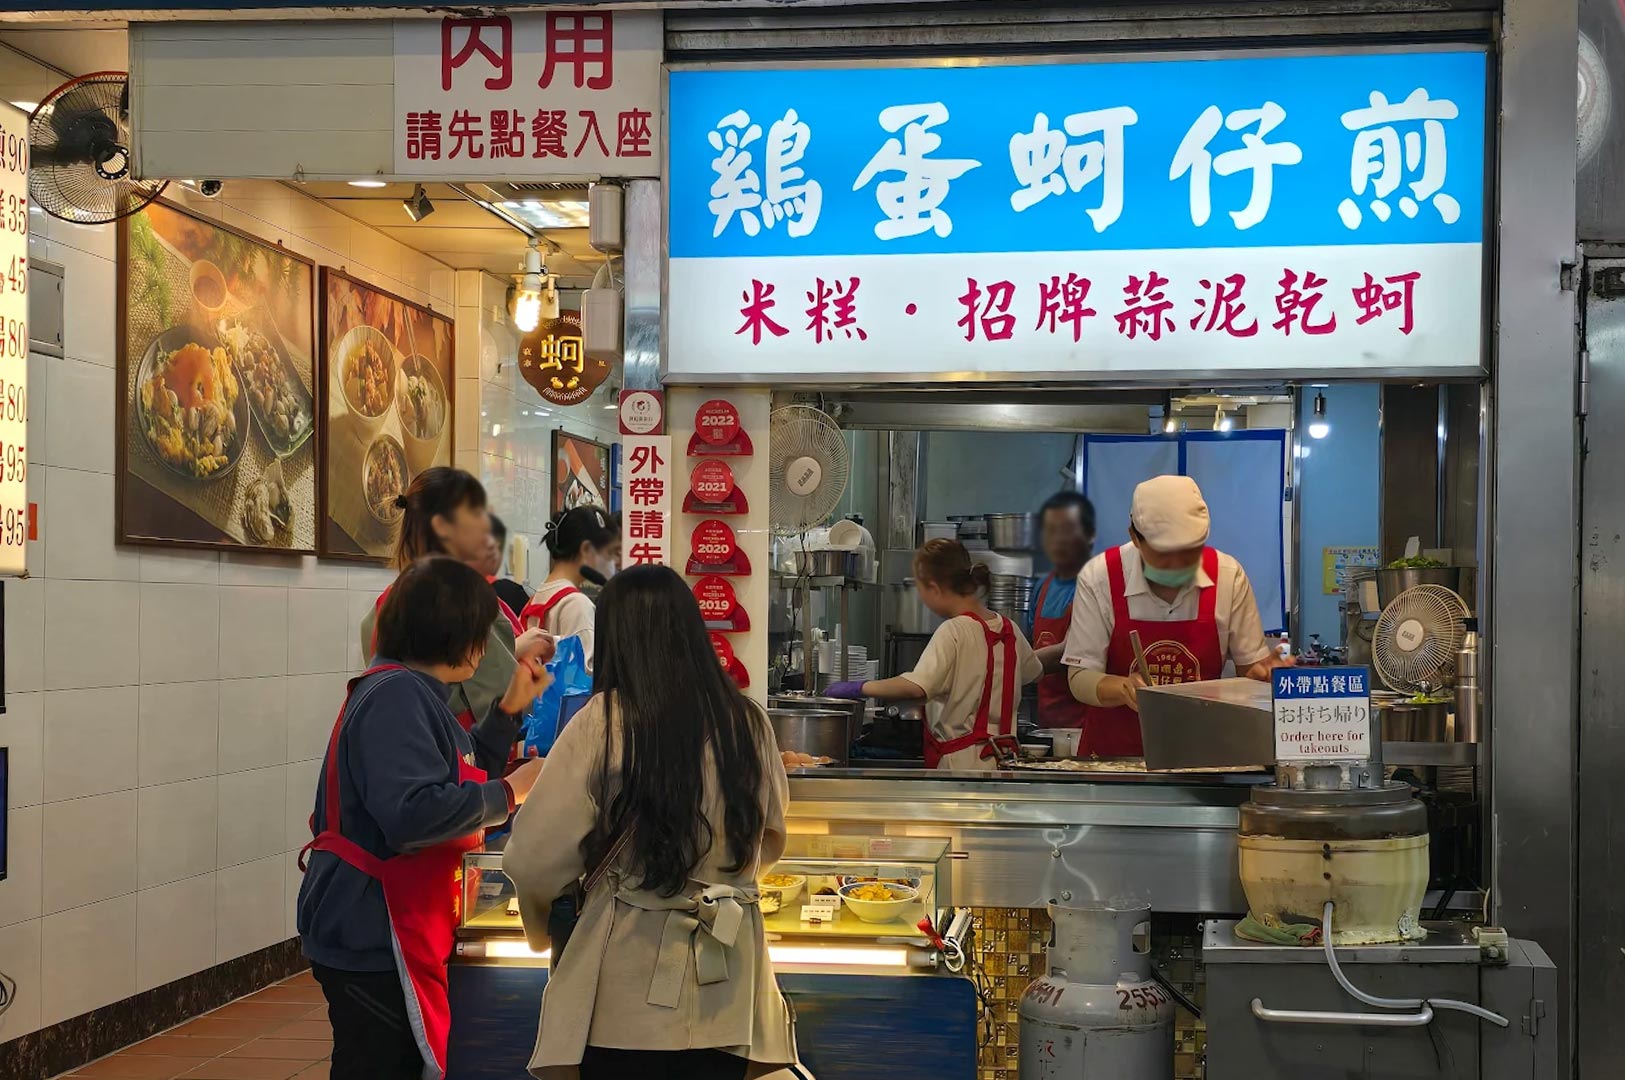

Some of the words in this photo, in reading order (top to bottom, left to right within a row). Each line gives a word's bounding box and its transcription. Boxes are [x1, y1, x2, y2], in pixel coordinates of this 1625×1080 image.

[407, 108, 652, 160] 請先點餐入座
[539, 334, 584, 373] 蚵
[702, 415, 735, 426] 2022
[698, 482, 727, 492] 2021
[629, 446, 664, 566] 外帶請先
[698, 544, 730, 554] 2020
[699, 600, 730, 610] 2019
[1279, 675, 1364, 694] 外帶點餐區
[1278, 705, 1366, 724] お持ち帰り
[1281, 731, 1315, 742] Order
[1317, 731, 1344, 741] here
[1347, 730, 1365, 741] for
[1299, 743, 1350, 754] takeouts
